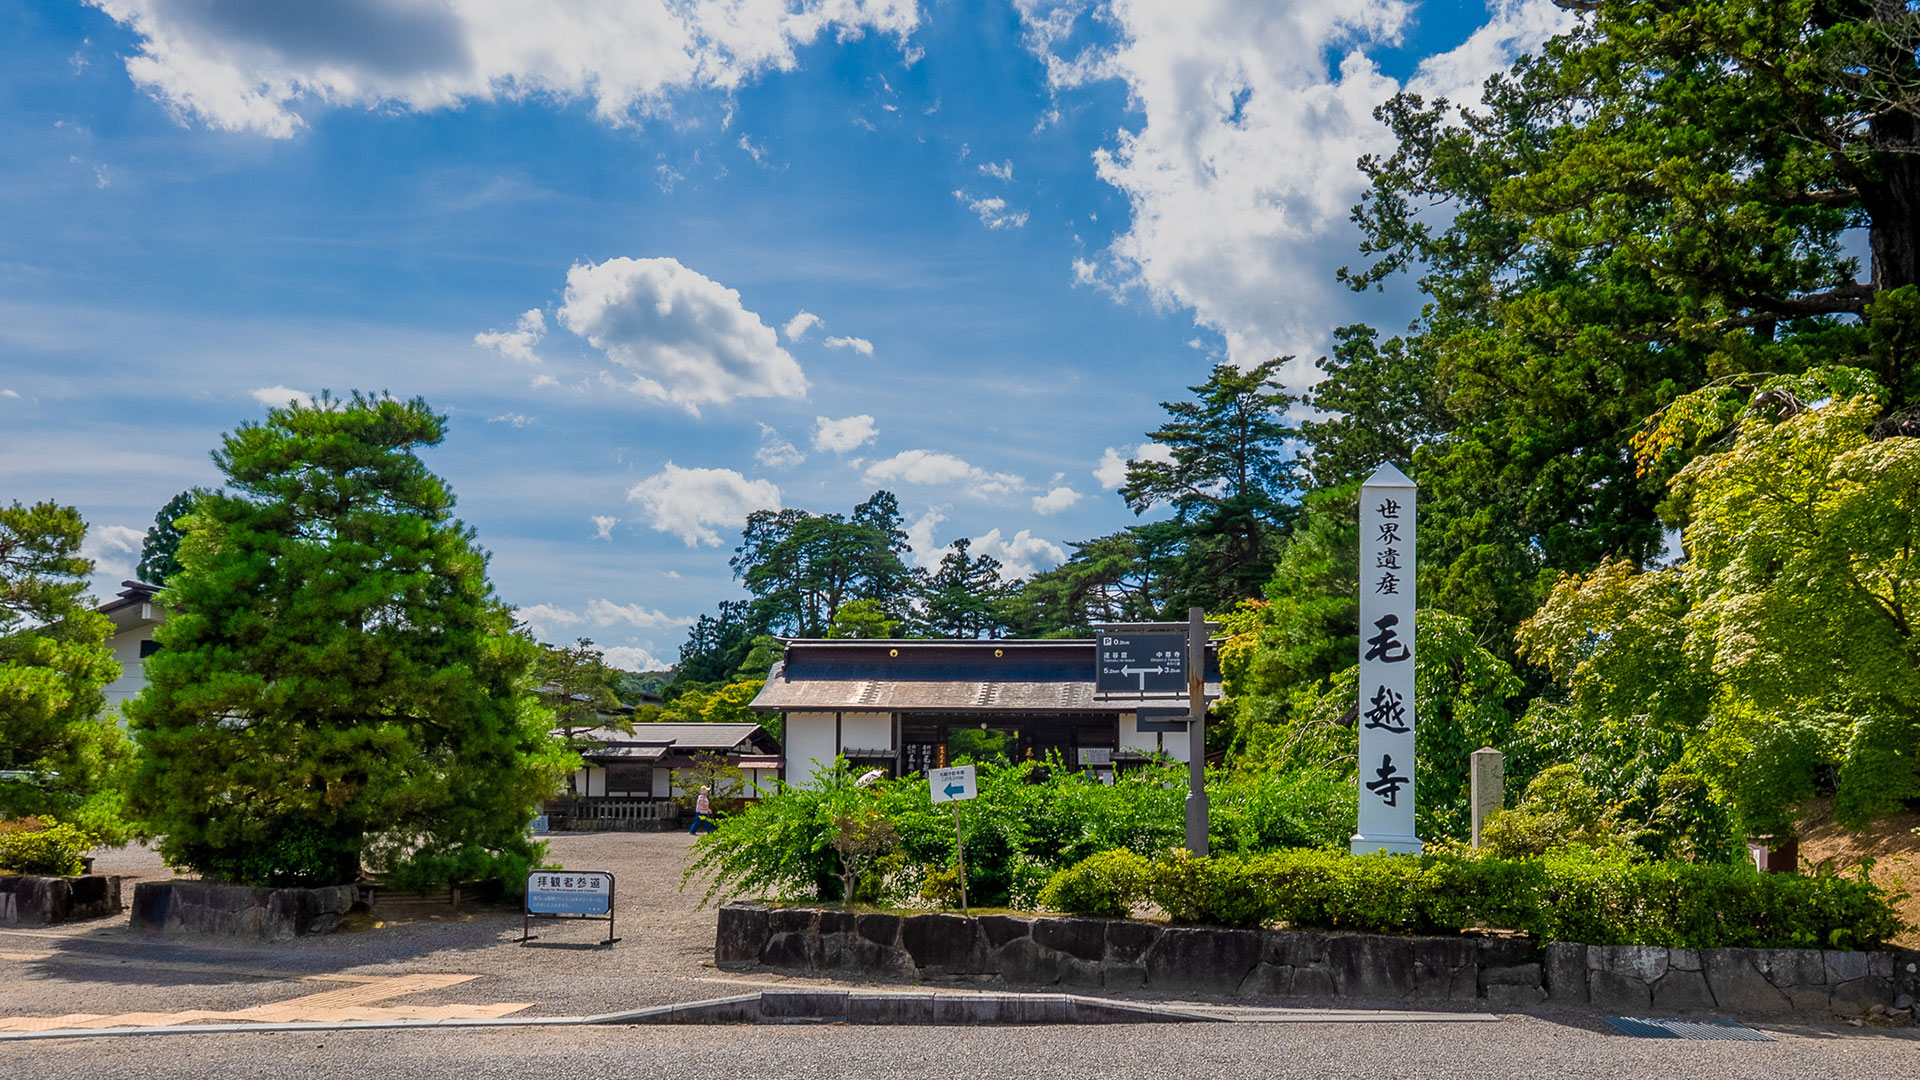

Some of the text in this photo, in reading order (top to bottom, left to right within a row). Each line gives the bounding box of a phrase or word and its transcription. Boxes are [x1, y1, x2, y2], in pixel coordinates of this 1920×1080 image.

[1364, 498, 1411, 807] 世界遺産 毛越寺
[538, 876, 600, 888] 拝観者参道
